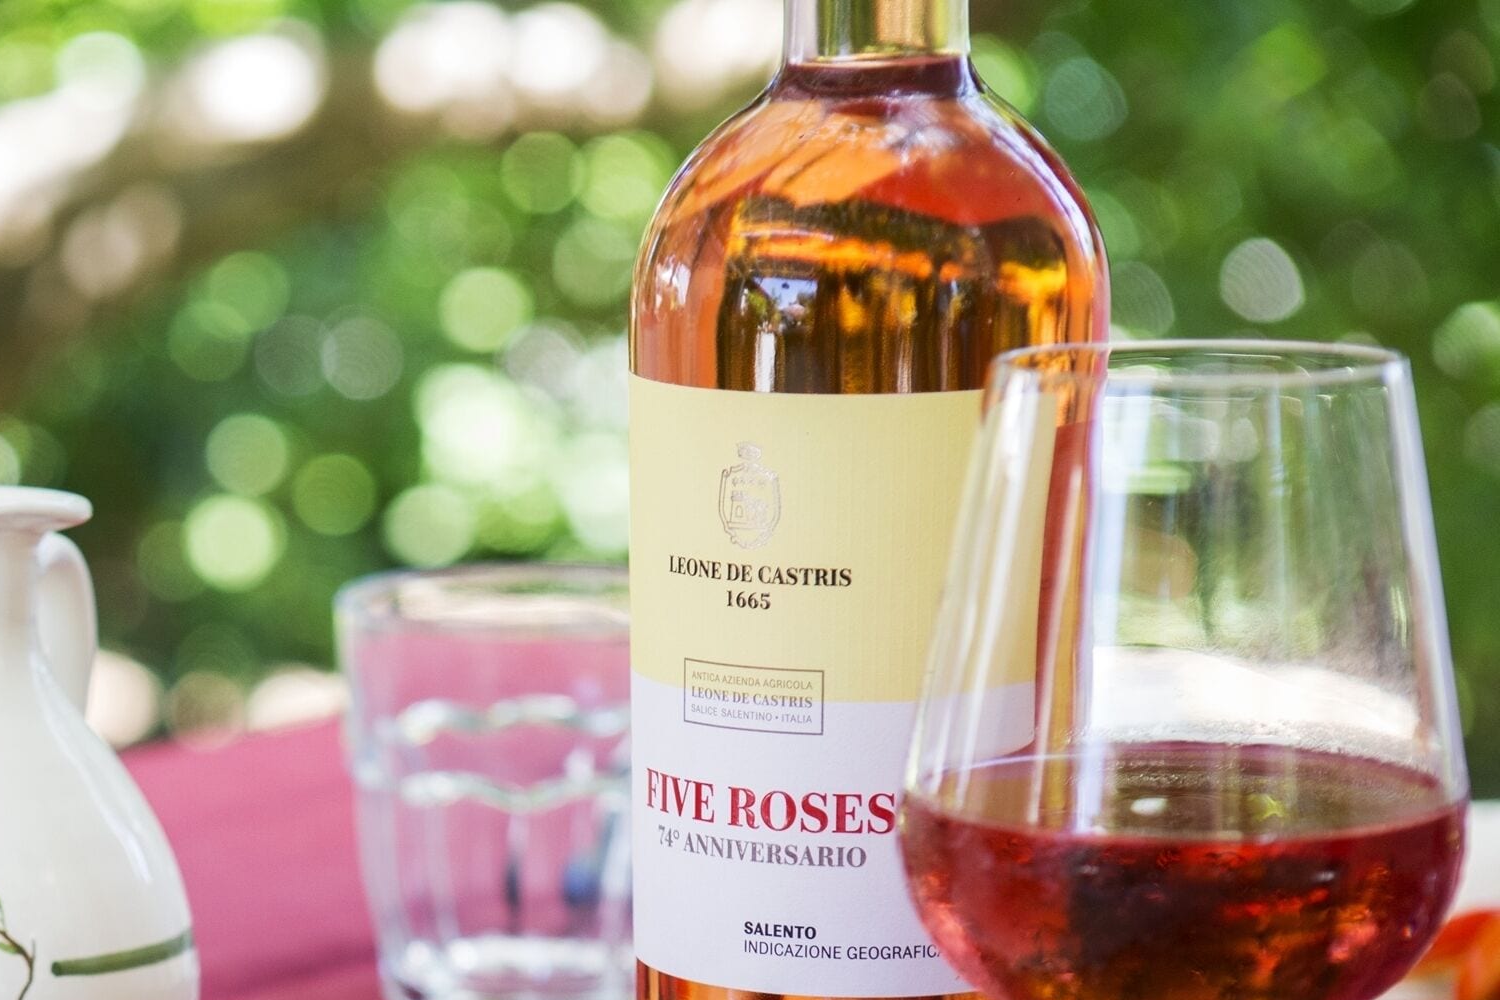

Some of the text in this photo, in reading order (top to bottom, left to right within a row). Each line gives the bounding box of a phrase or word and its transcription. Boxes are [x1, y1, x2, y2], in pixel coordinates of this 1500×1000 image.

[669, 555, 852, 587] LEONE DE CASTRIS
[726, 590, 771, 610] 1665
[691, 671, 813, 690] ANTICA AZIENDA AGRICOLA
[691, 685, 813, 709] LEONE DE CASTRIS
[691, 703, 813, 724] SALICE SALENTINO ITALIA
[646, 767, 896, 835] FIVE ROSES
[683, 832, 867, 868] ANNIVERSARIO
[744, 921, 817, 940] SALENTO
[744, 939, 842, 960] INDICAZIONE
